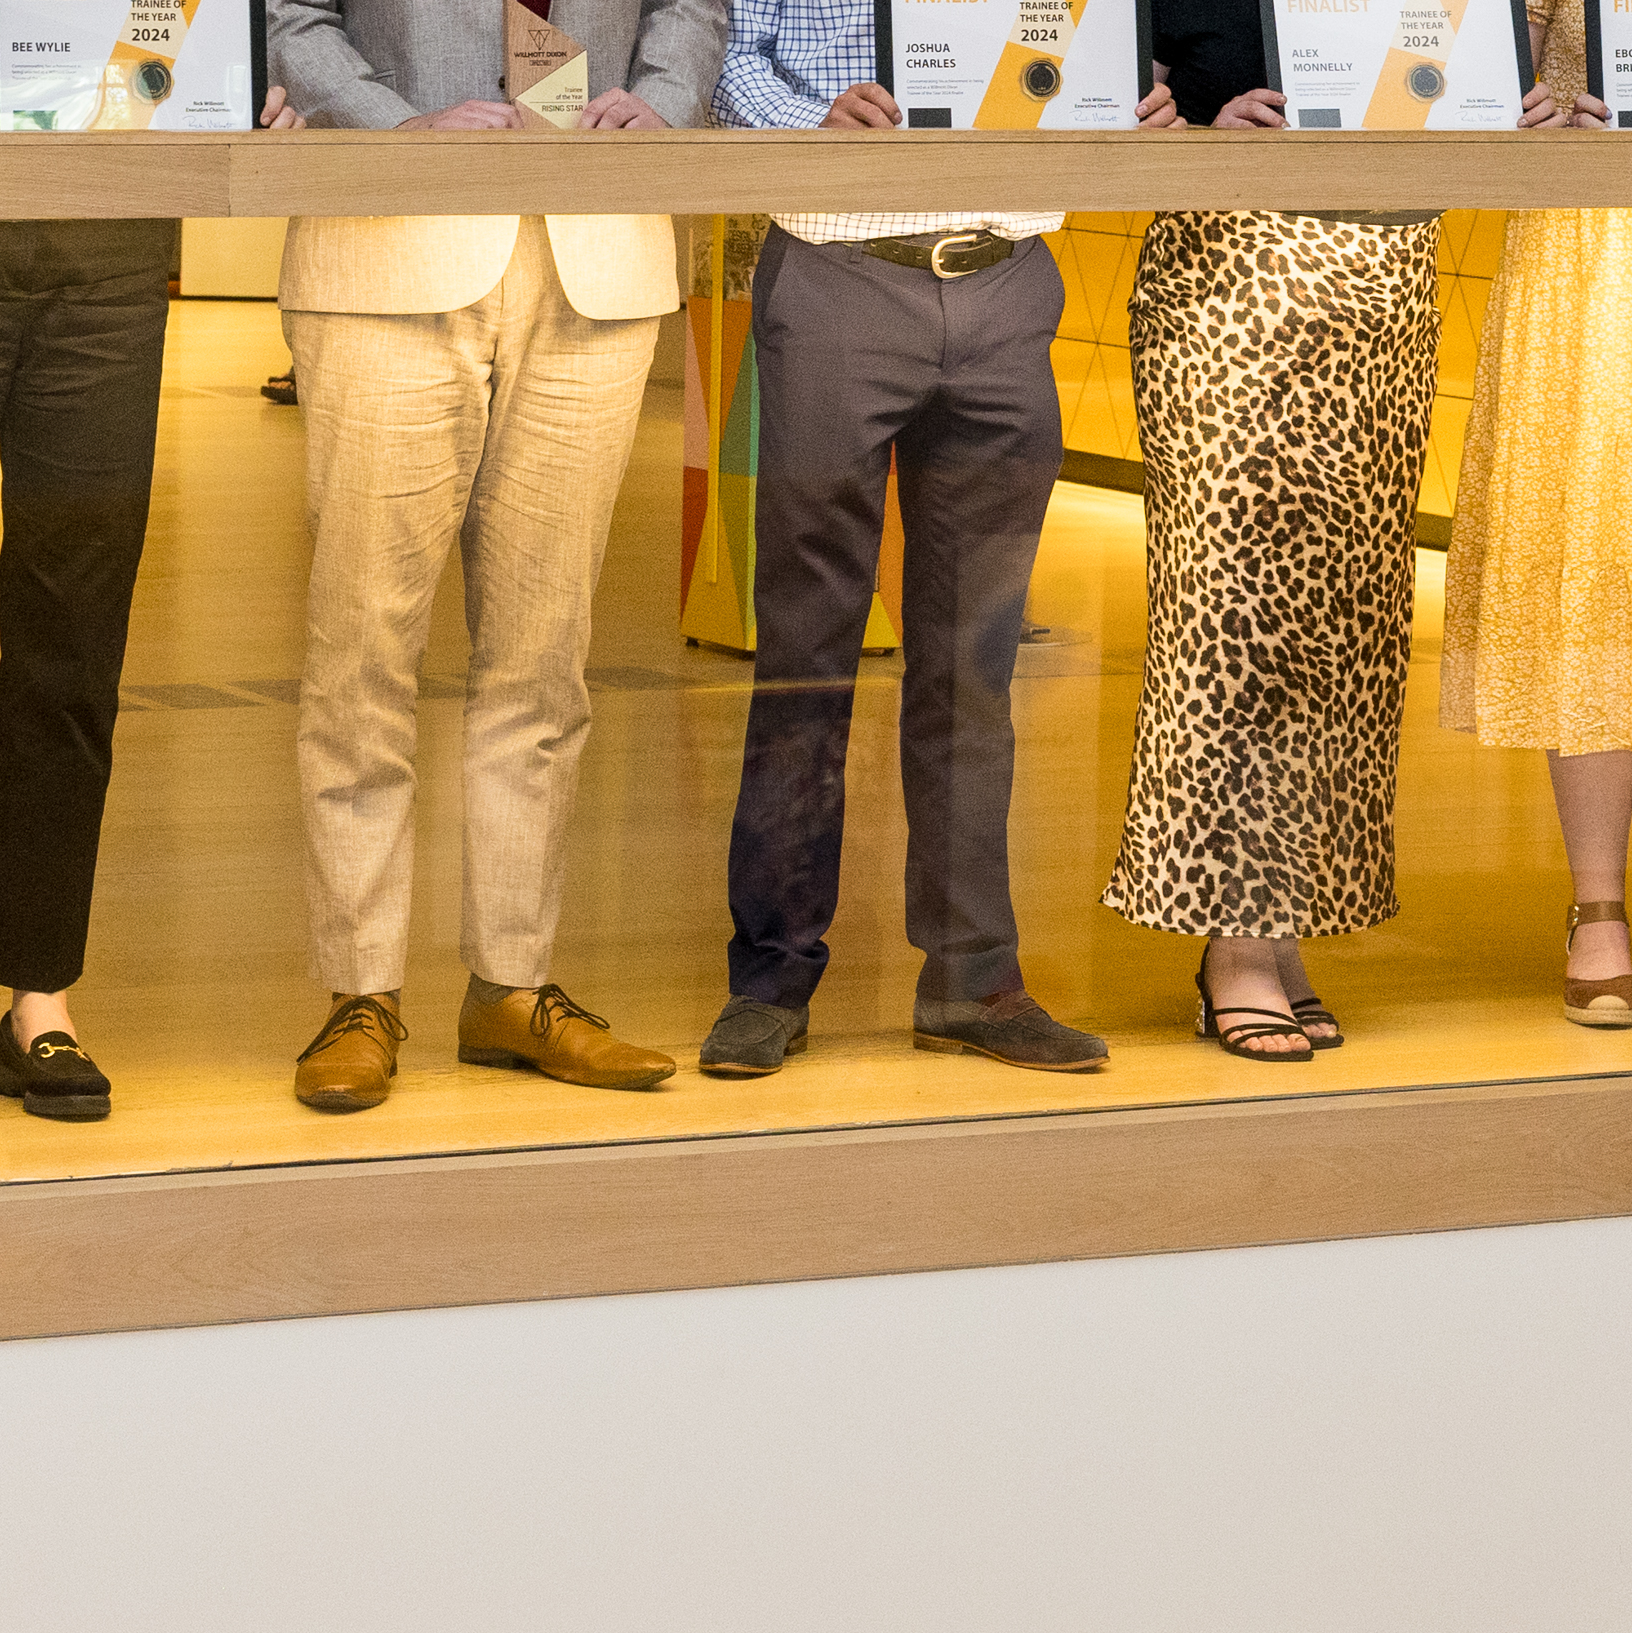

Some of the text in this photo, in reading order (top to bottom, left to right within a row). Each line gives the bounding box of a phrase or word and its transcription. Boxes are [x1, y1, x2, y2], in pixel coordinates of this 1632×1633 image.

[131, 0, 187, 9] TRAINEE OF
[1020, 2, 1073, 10] TRAINEE OF
[131, 12, 177, 22] THE YEAR
[1020, 14, 1064, 22] THE YEAR
[1399, 10, 1452, 19] TRAINEE OF
[1401, 22, 1444, 30] THE YEAR
[131, 28, 170, 42] 2024
[1021, 29, 1058, 42] 2024
[12, 42, 71, 52] BEE WYLIE
[1403, 36, 1439, 48] 2024
[905, 44, 951, 53] JOSHUA
[1292, 48, 1319, 58] ALEX
[906, 58, 956, 68] CHARLES
[1293, 62, 1353, 72] MONNELLY
[566, 104, 583, 112] STAR
